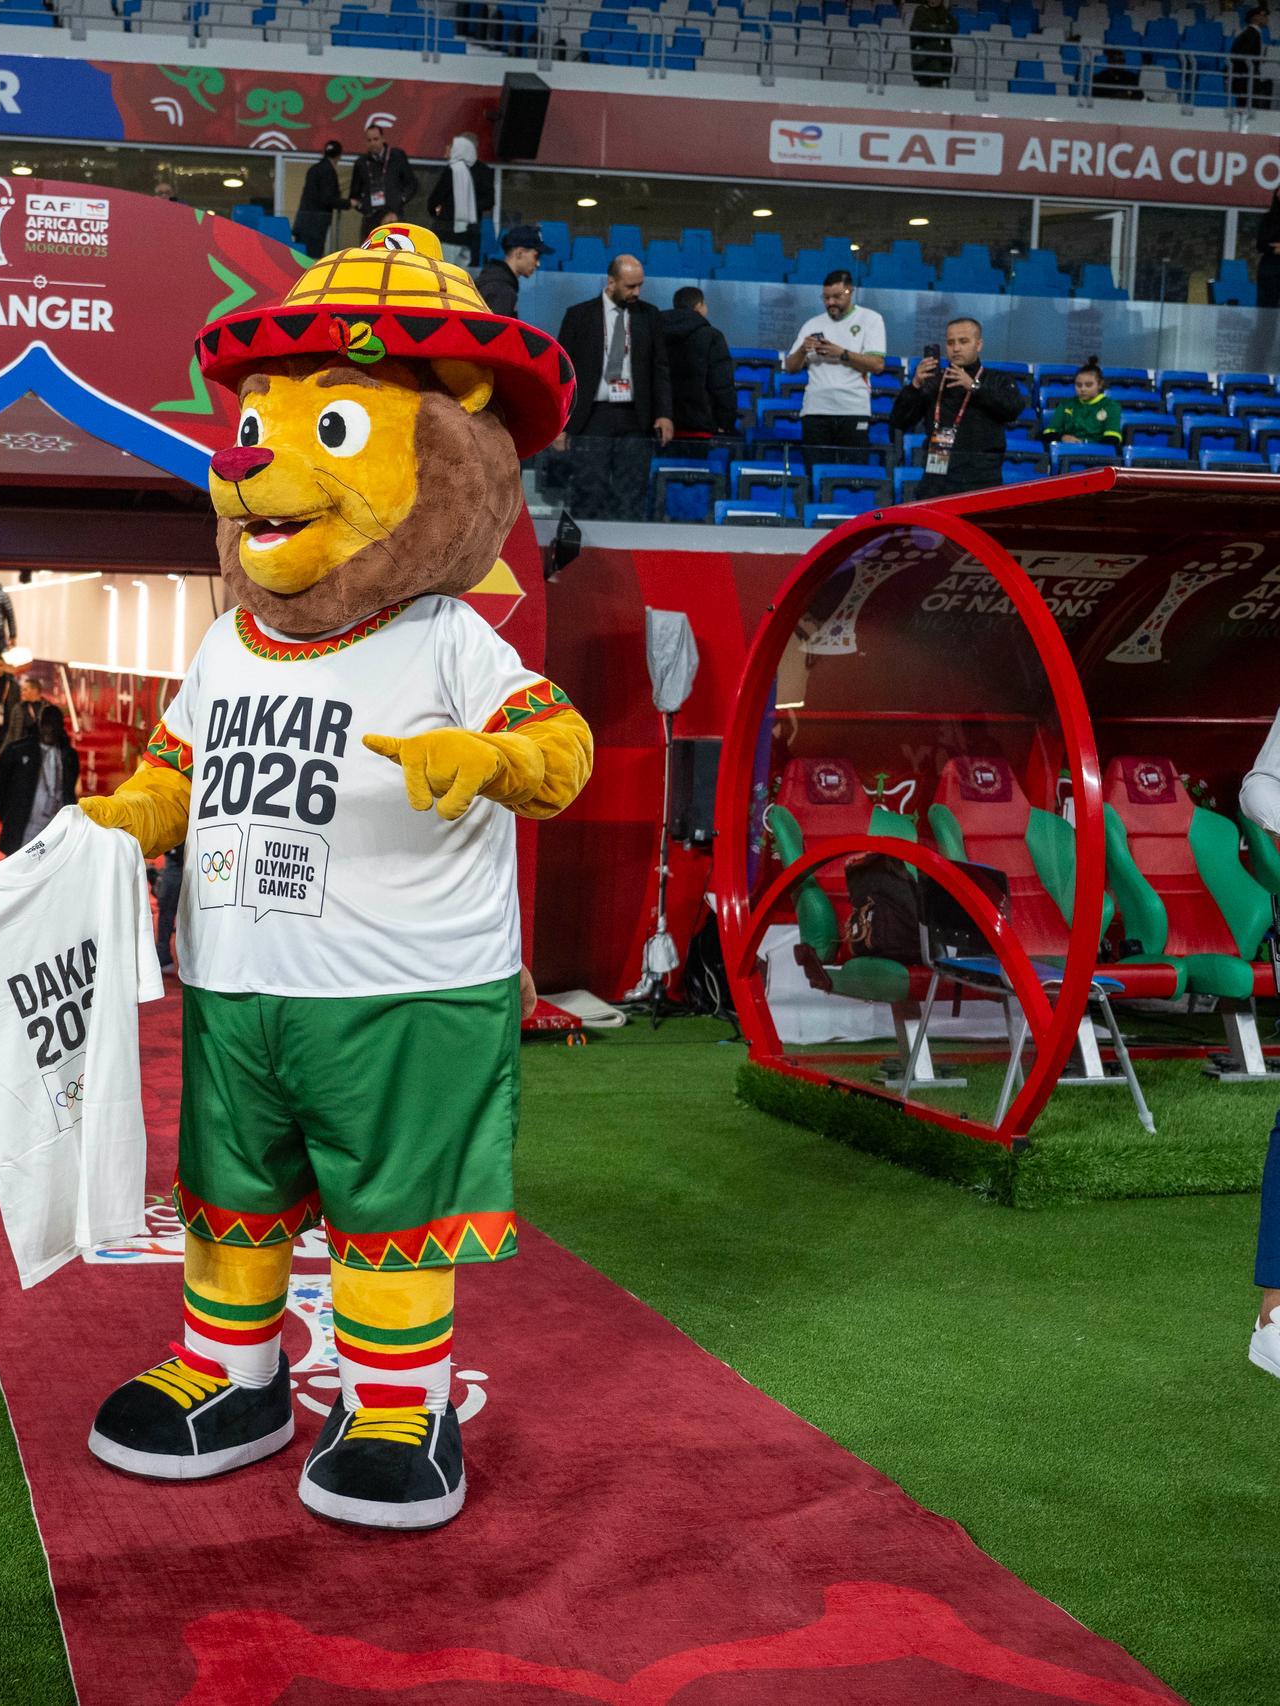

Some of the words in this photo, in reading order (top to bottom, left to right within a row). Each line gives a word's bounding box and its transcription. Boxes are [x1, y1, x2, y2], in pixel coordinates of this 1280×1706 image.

[859, 132, 976, 166] CAF
[1018, 137, 1163, 181] AFRICA
[1169, 148, 1248, 186] CUP
[29, 200, 70, 212] CAF
[26, 216, 77, 231] AFRICA
[80, 220, 109, 232] CUP
[25, 230, 45, 242] OF
[47, 231, 109, 246] NATIONS
[24, 242, 91, 257] MOROCCO
[94, 246, 108, 257] 25
[1052, 578, 1116, 598] CUP
[921, 593, 967, 613] OF
[1228, 601, 1275, 620] OF
[205, 695, 353, 758] DAKAR
[198, 751, 339, 826] 2026
[264, 840, 309, 863] YOUTH
[255, 858, 315, 882] OLYMPIC
[258, 878, 307, 900] GAMES
